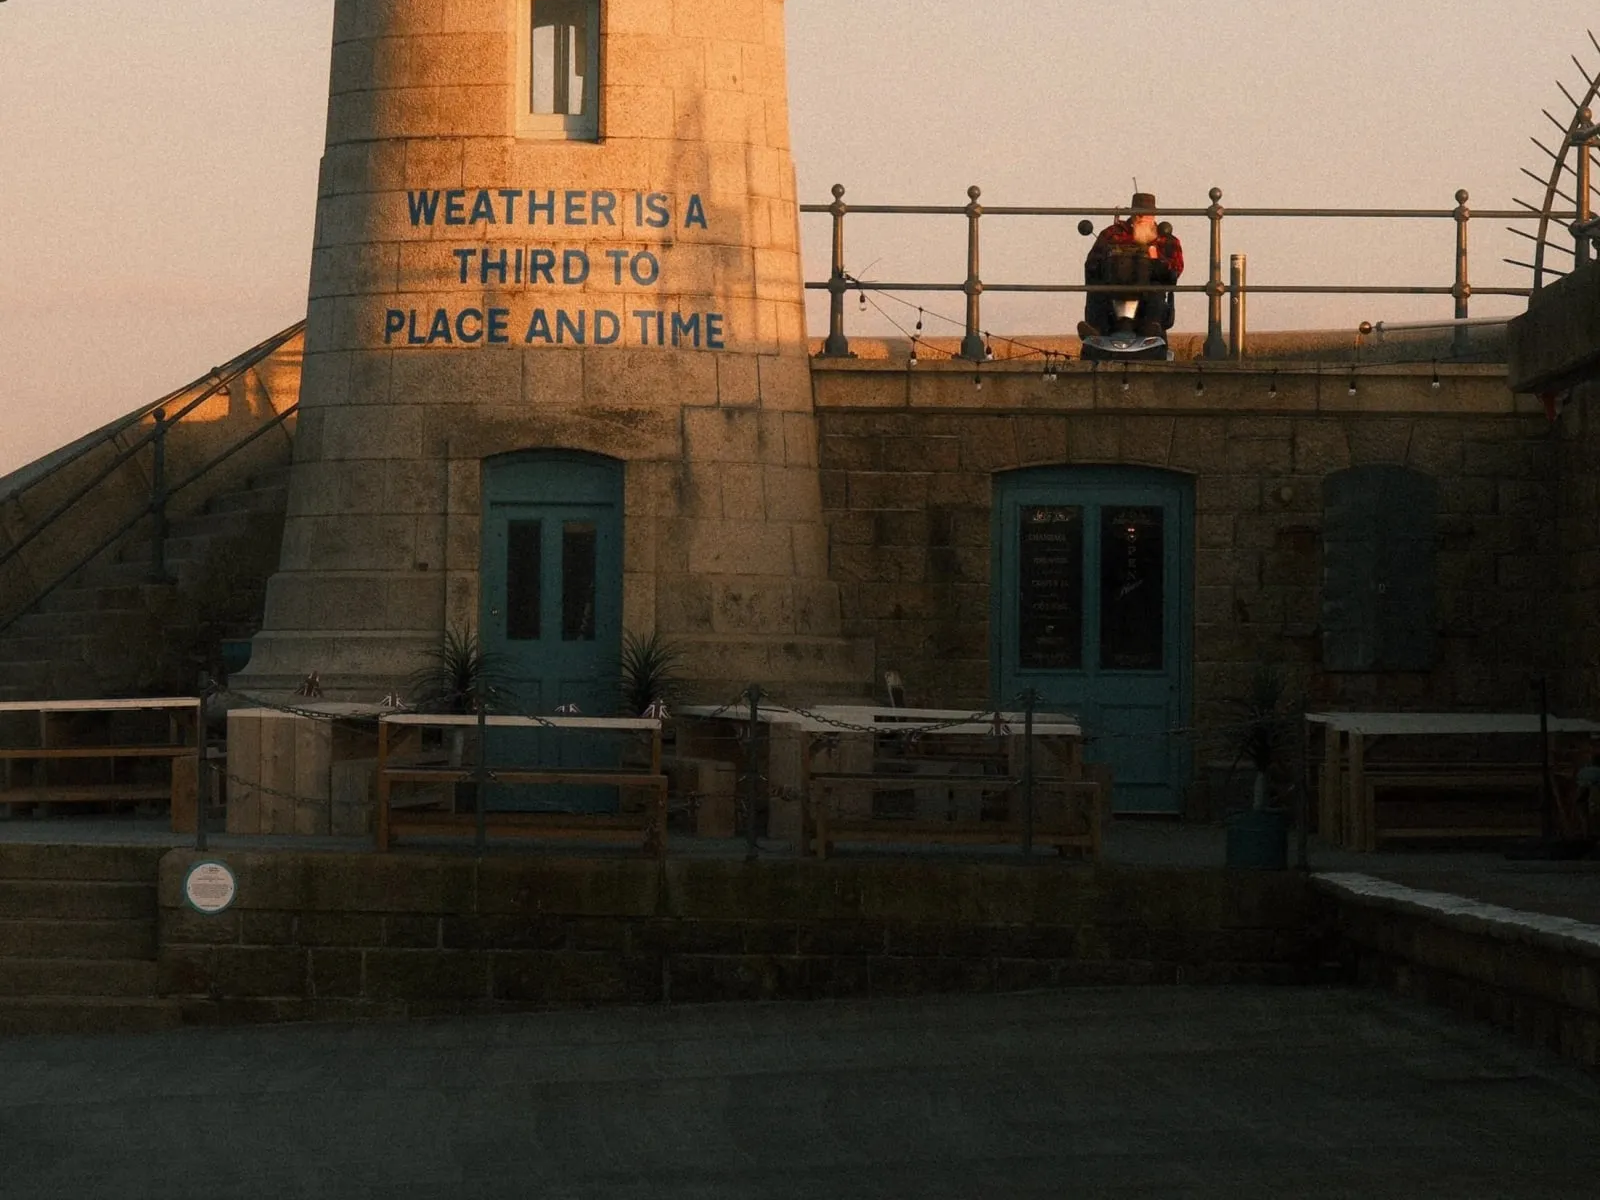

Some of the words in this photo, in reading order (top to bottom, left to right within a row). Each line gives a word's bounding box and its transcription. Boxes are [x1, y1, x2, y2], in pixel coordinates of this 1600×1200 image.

[407, 189, 616, 226] WEATHER
[635, 191, 670, 228] IS
[684, 193, 708, 229] A
[453, 248, 590, 285] THIRD
[605, 249, 659, 286] TO
[384, 307, 510, 344] PLACE
[524, 308, 620, 345] AND
[632, 309, 725, 349] TIME
